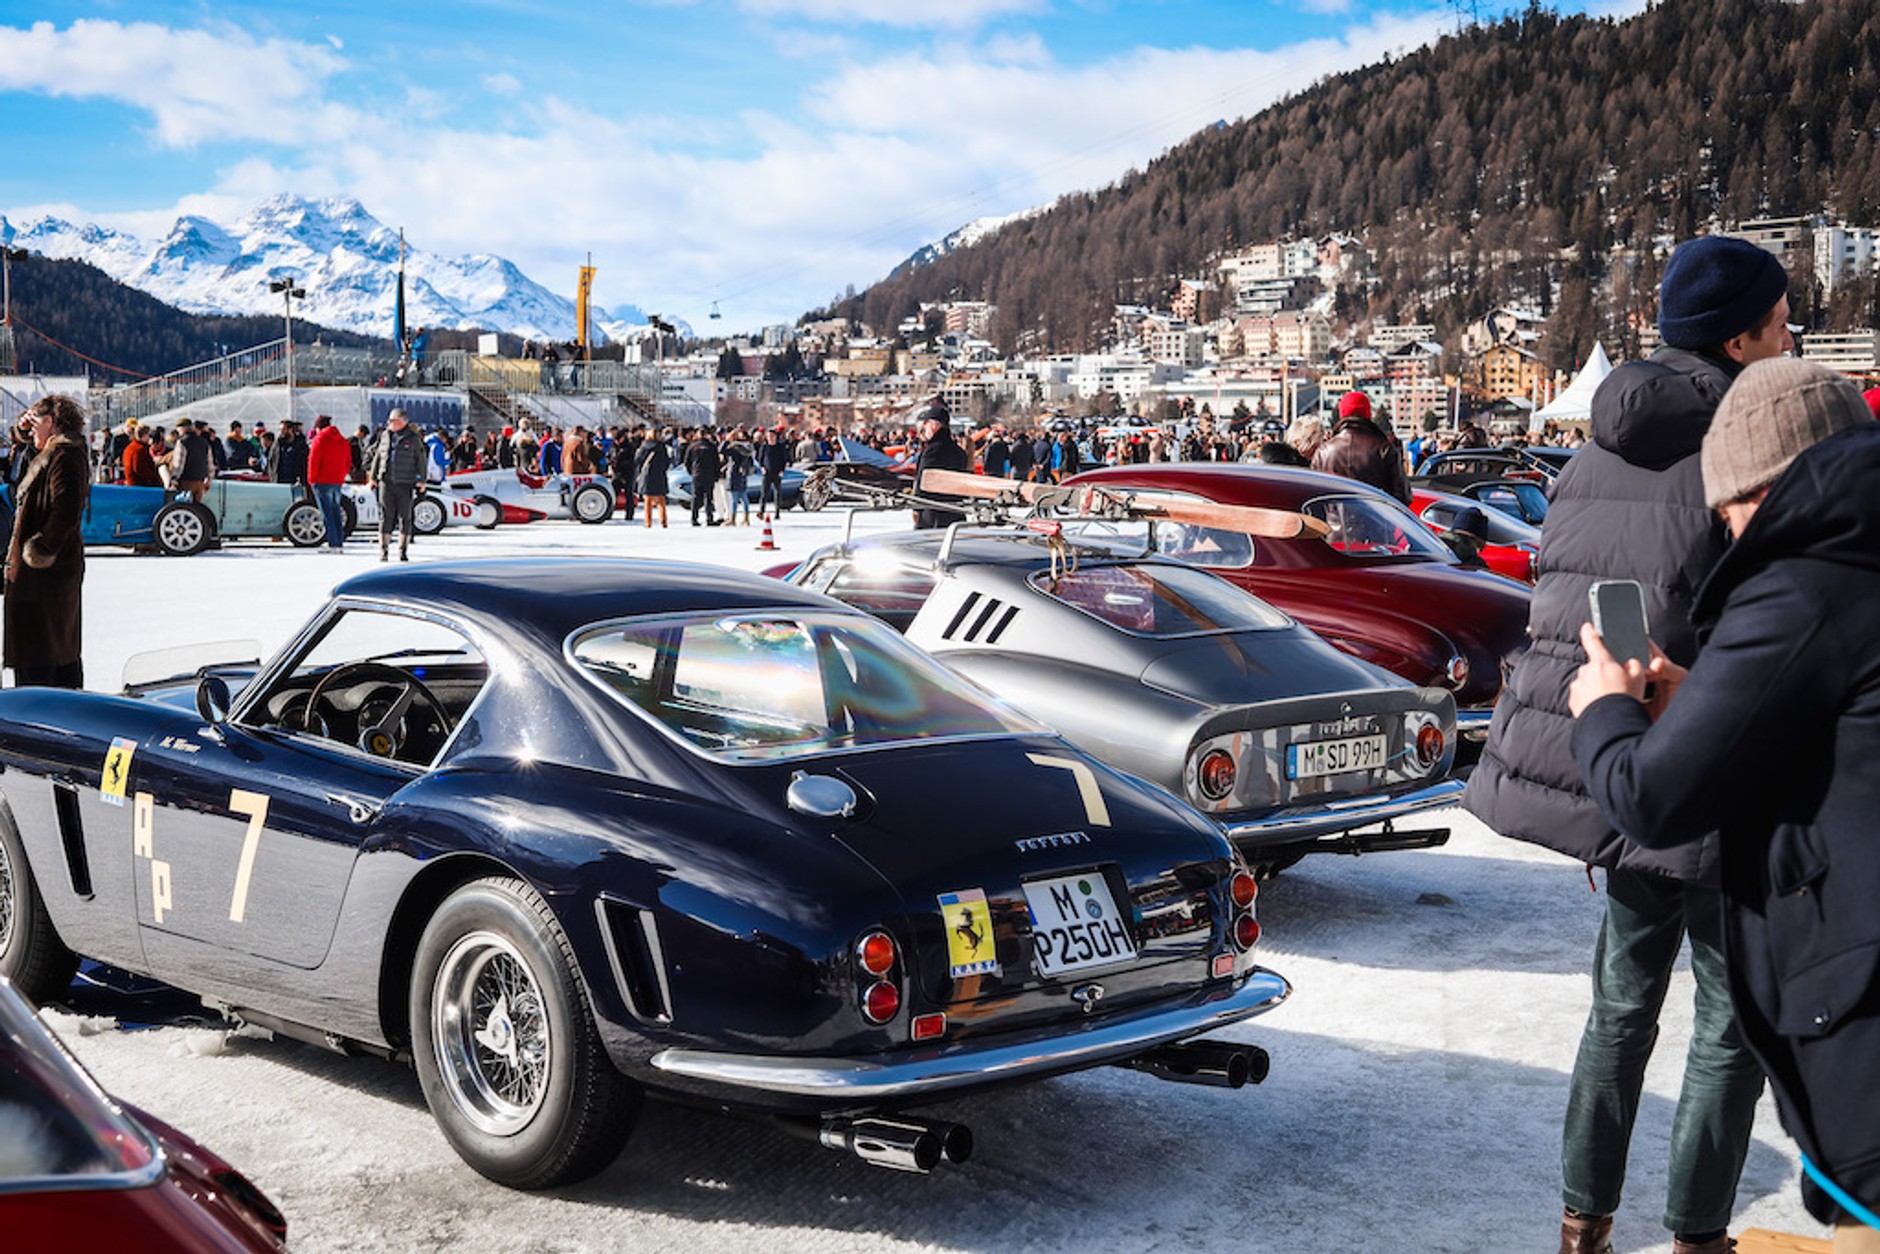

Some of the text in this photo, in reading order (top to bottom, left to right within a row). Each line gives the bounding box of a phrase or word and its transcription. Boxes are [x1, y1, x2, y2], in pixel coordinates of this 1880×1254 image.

[1303, 739, 1382, 774] M SD 99H
[1025, 752, 1112, 828] 7
[134, 791, 155, 859] A
[228, 788, 271, 923] 7
[151, 859, 173, 924] P
[1049, 883, 1081, 922] M
[1033, 917, 1133, 968] P250H
